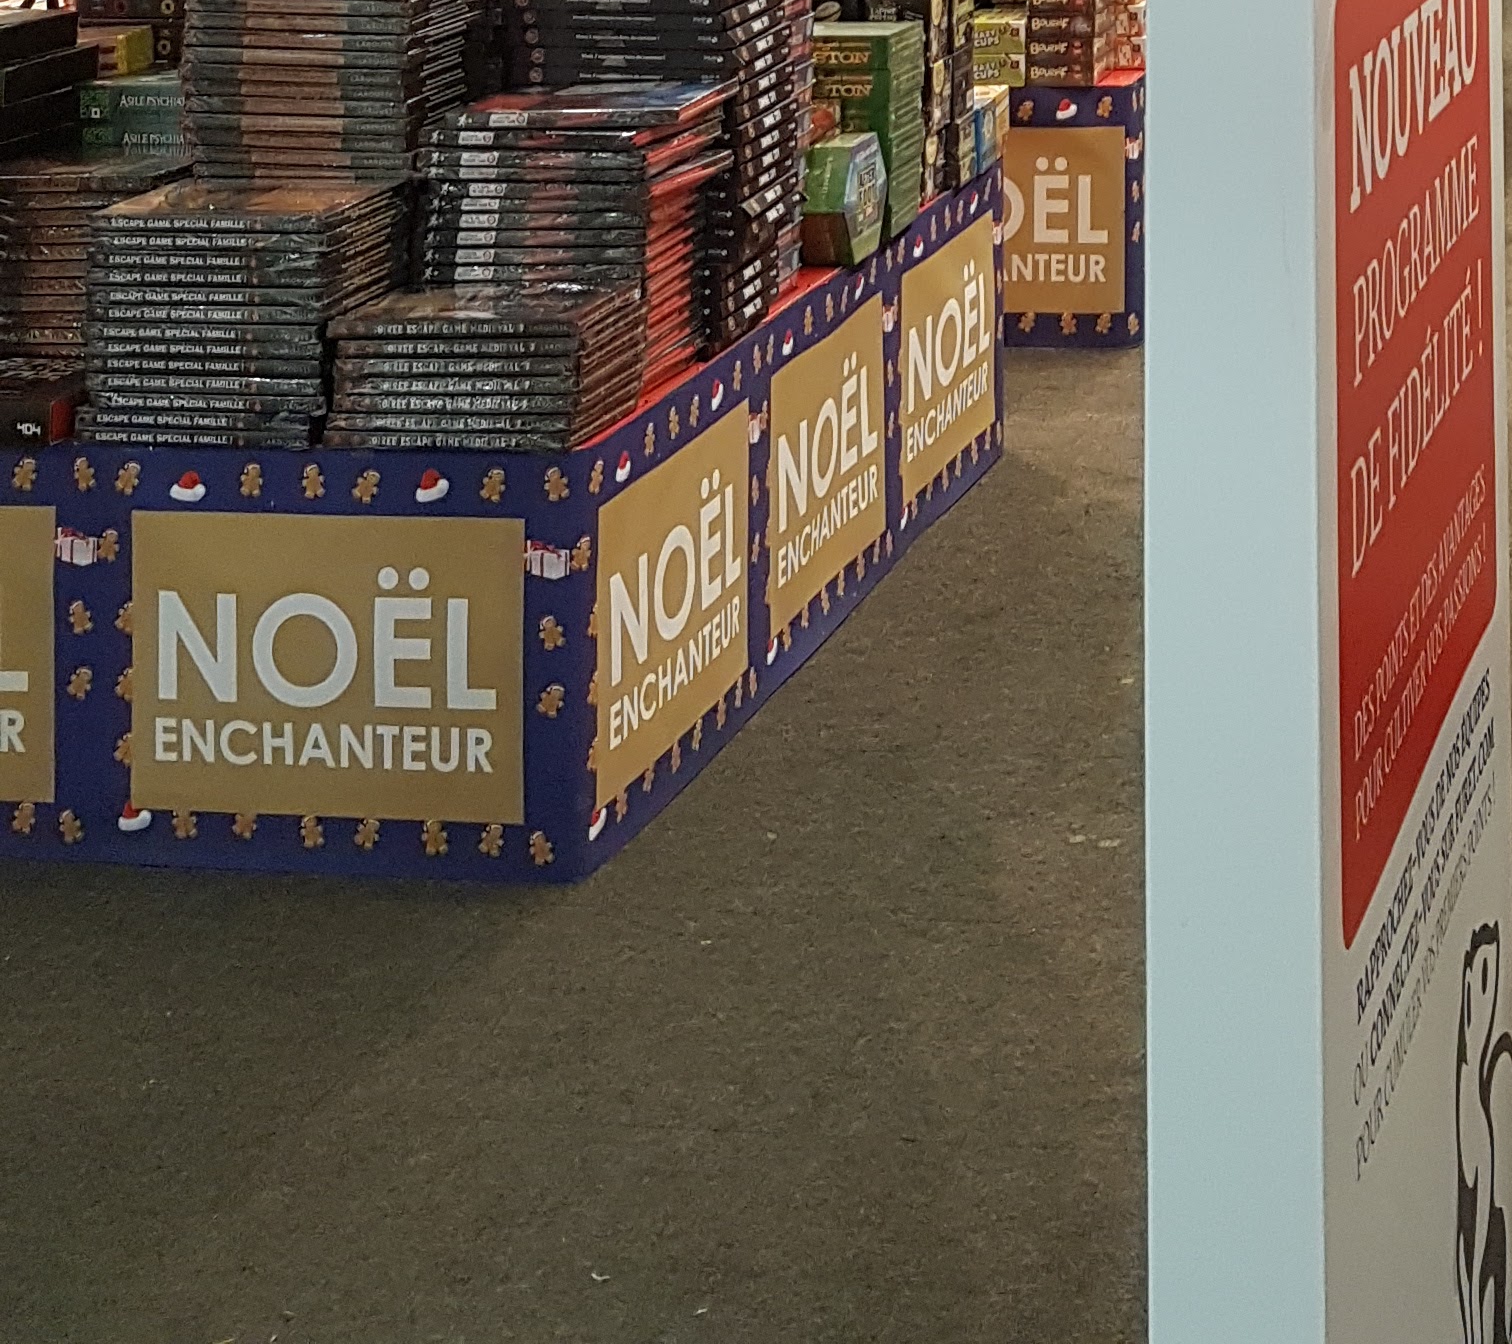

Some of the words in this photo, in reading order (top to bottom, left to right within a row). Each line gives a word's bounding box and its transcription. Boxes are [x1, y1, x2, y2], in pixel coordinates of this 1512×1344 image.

[1003, 157, 1108, 243] ËL
[1003, 254, 1106, 283] NTEUR
[1352, 134, 1479, 389] PROGRAMME
[907, 259, 991, 413] NOËL
[16, 422, 41, 435] 404
[776, 351, 879, 532] NOËL
[906, 362, 989, 463] ENCHANTEUR
[778, 462, 879, 589] ENCHANTEUR
[1350, 426, 1382, 579] DE
[156, 566, 497, 710] NOËL
[609, 468, 742, 687] NOËL
[1354, 685, 1375, 761] DES
[1376, 612, 1410, 714] POINTS
[1409, 585, 1422, 645] ET
[1421, 552, 1439, 619] DES
[1438, 463, 1486, 583] AVANTAGES
[608, 594, 741, 752] ENCHANTEUR
[1355, 746, 1383, 842] POUR
[1383, 650, 1428, 775] CULTIVER
[1426, 617, 1443, 677] VOS
[154, 717, 494, 774] ENCHANTEUR
[1353, 1040, 1369, 1106] OU
[1356, 1086, 1385, 1182] POUR
